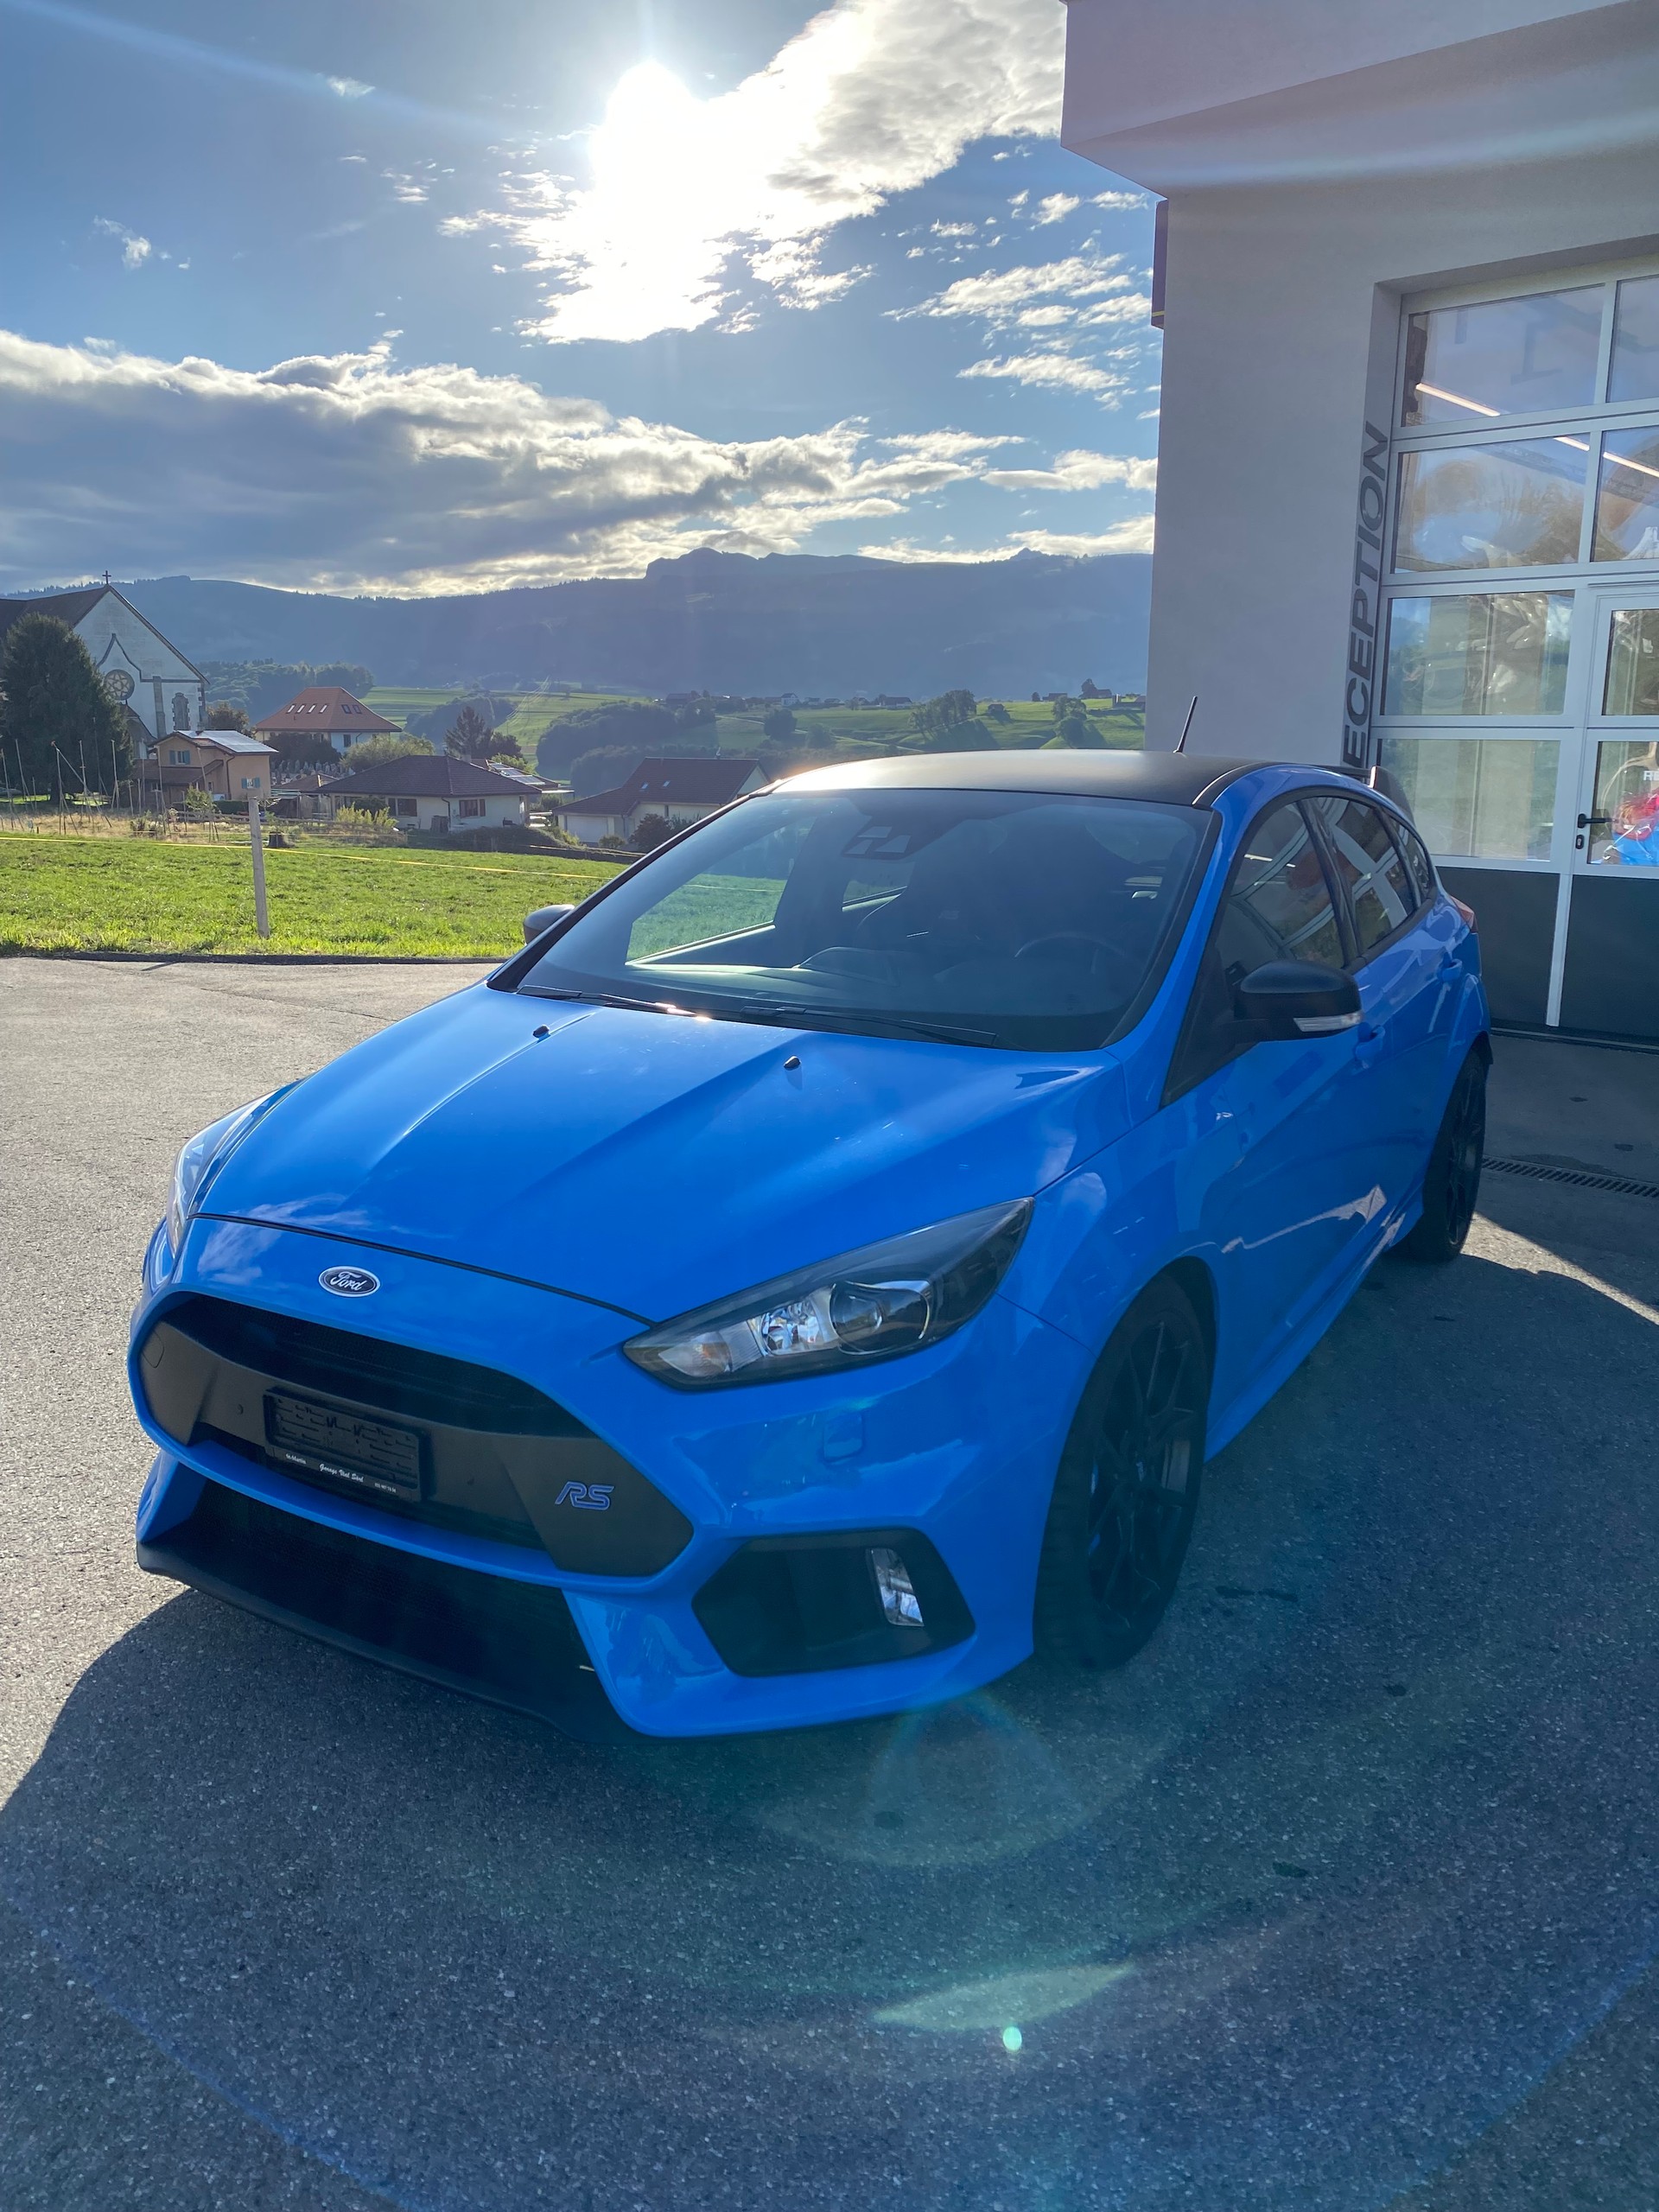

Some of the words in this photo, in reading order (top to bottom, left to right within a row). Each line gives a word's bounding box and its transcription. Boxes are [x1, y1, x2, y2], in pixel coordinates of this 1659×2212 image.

[1342, 420, 1389, 768] ECEPTION
[330, 1271, 368, 1291] Ford
[319, 1463, 338, 1475] Garage
[554, 1481, 614, 1511] RS
